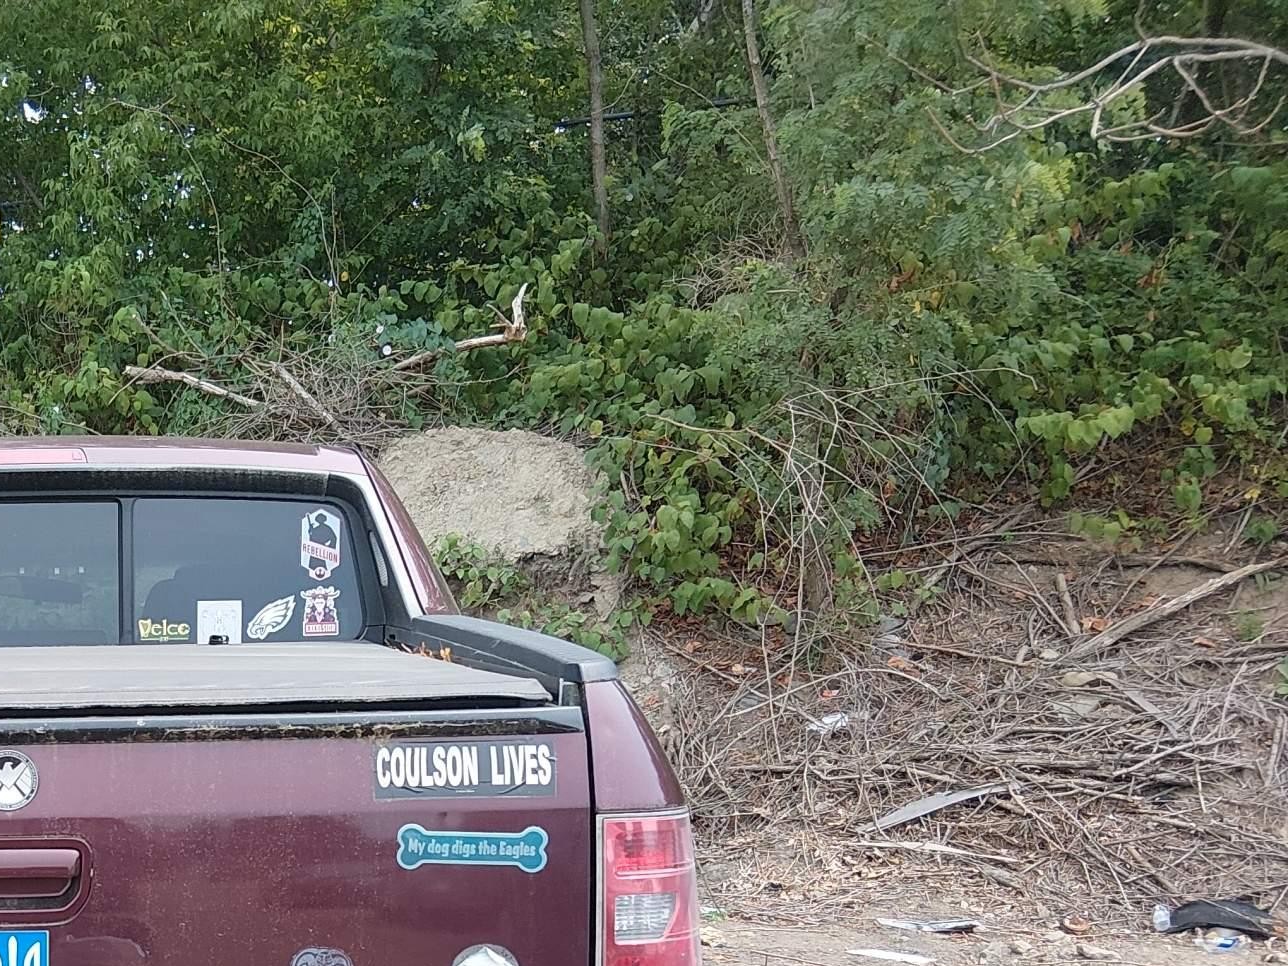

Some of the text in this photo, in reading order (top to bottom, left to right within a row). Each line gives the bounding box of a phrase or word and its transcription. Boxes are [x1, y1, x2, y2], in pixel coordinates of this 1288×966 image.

[302, 543, 338, 563] REBELLION
[376, 744, 552, 788] COULSON LIVES
[407, 838, 536, 859] My dog digs the Eagles
